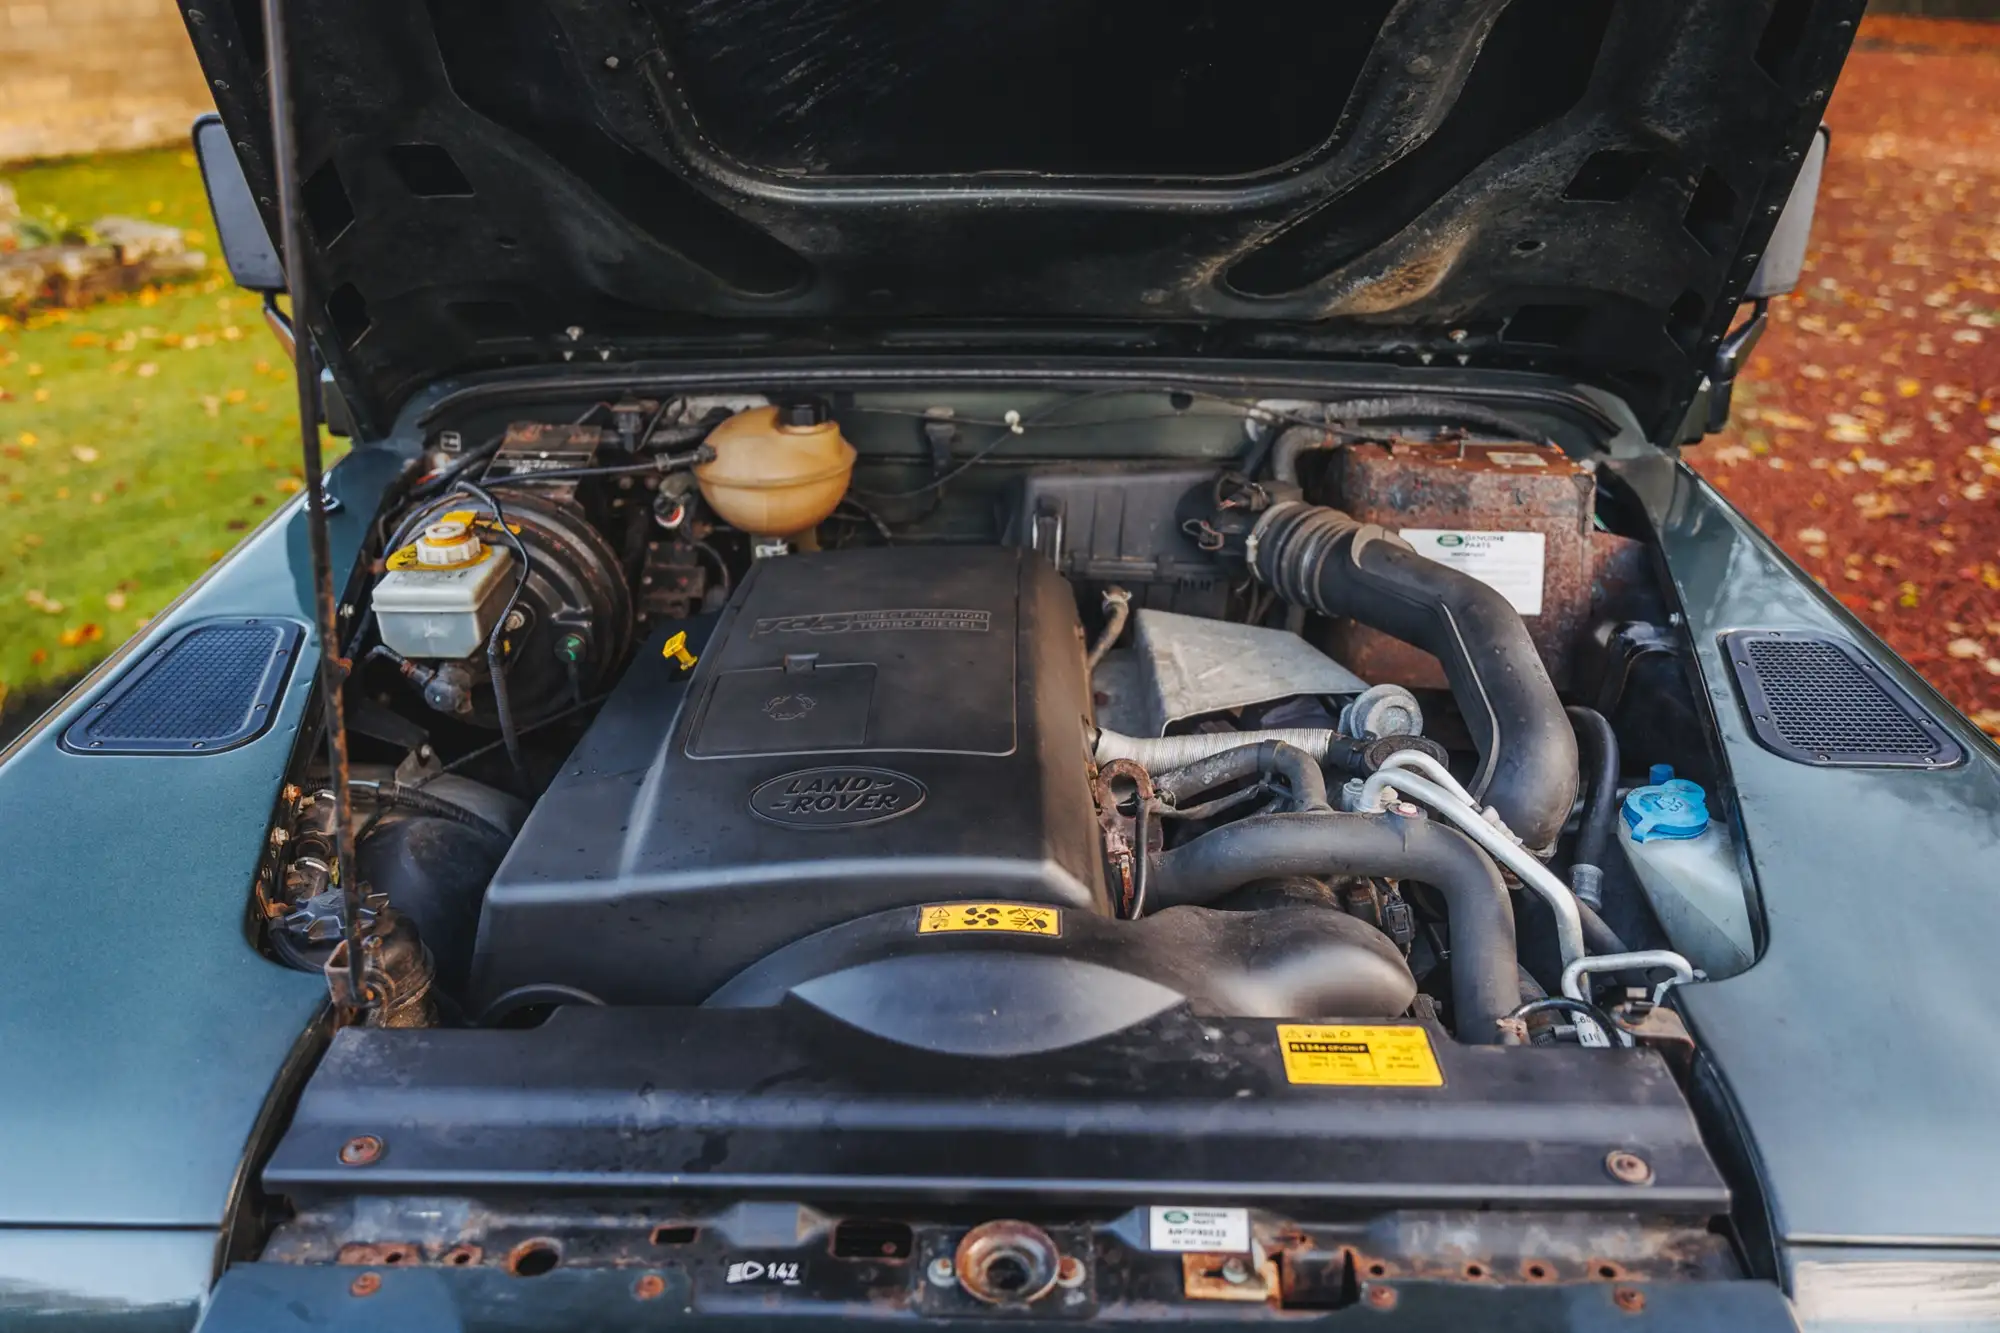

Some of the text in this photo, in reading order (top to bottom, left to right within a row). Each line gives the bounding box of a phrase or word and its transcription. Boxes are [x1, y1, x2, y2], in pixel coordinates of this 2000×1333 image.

[856, 611, 986, 620] DIRECT INJECTION
[859, 620, 977, 629] TURBO DIESEL
[784, 776, 873, 796] LAND
[789, 793, 900, 814] ROVER
